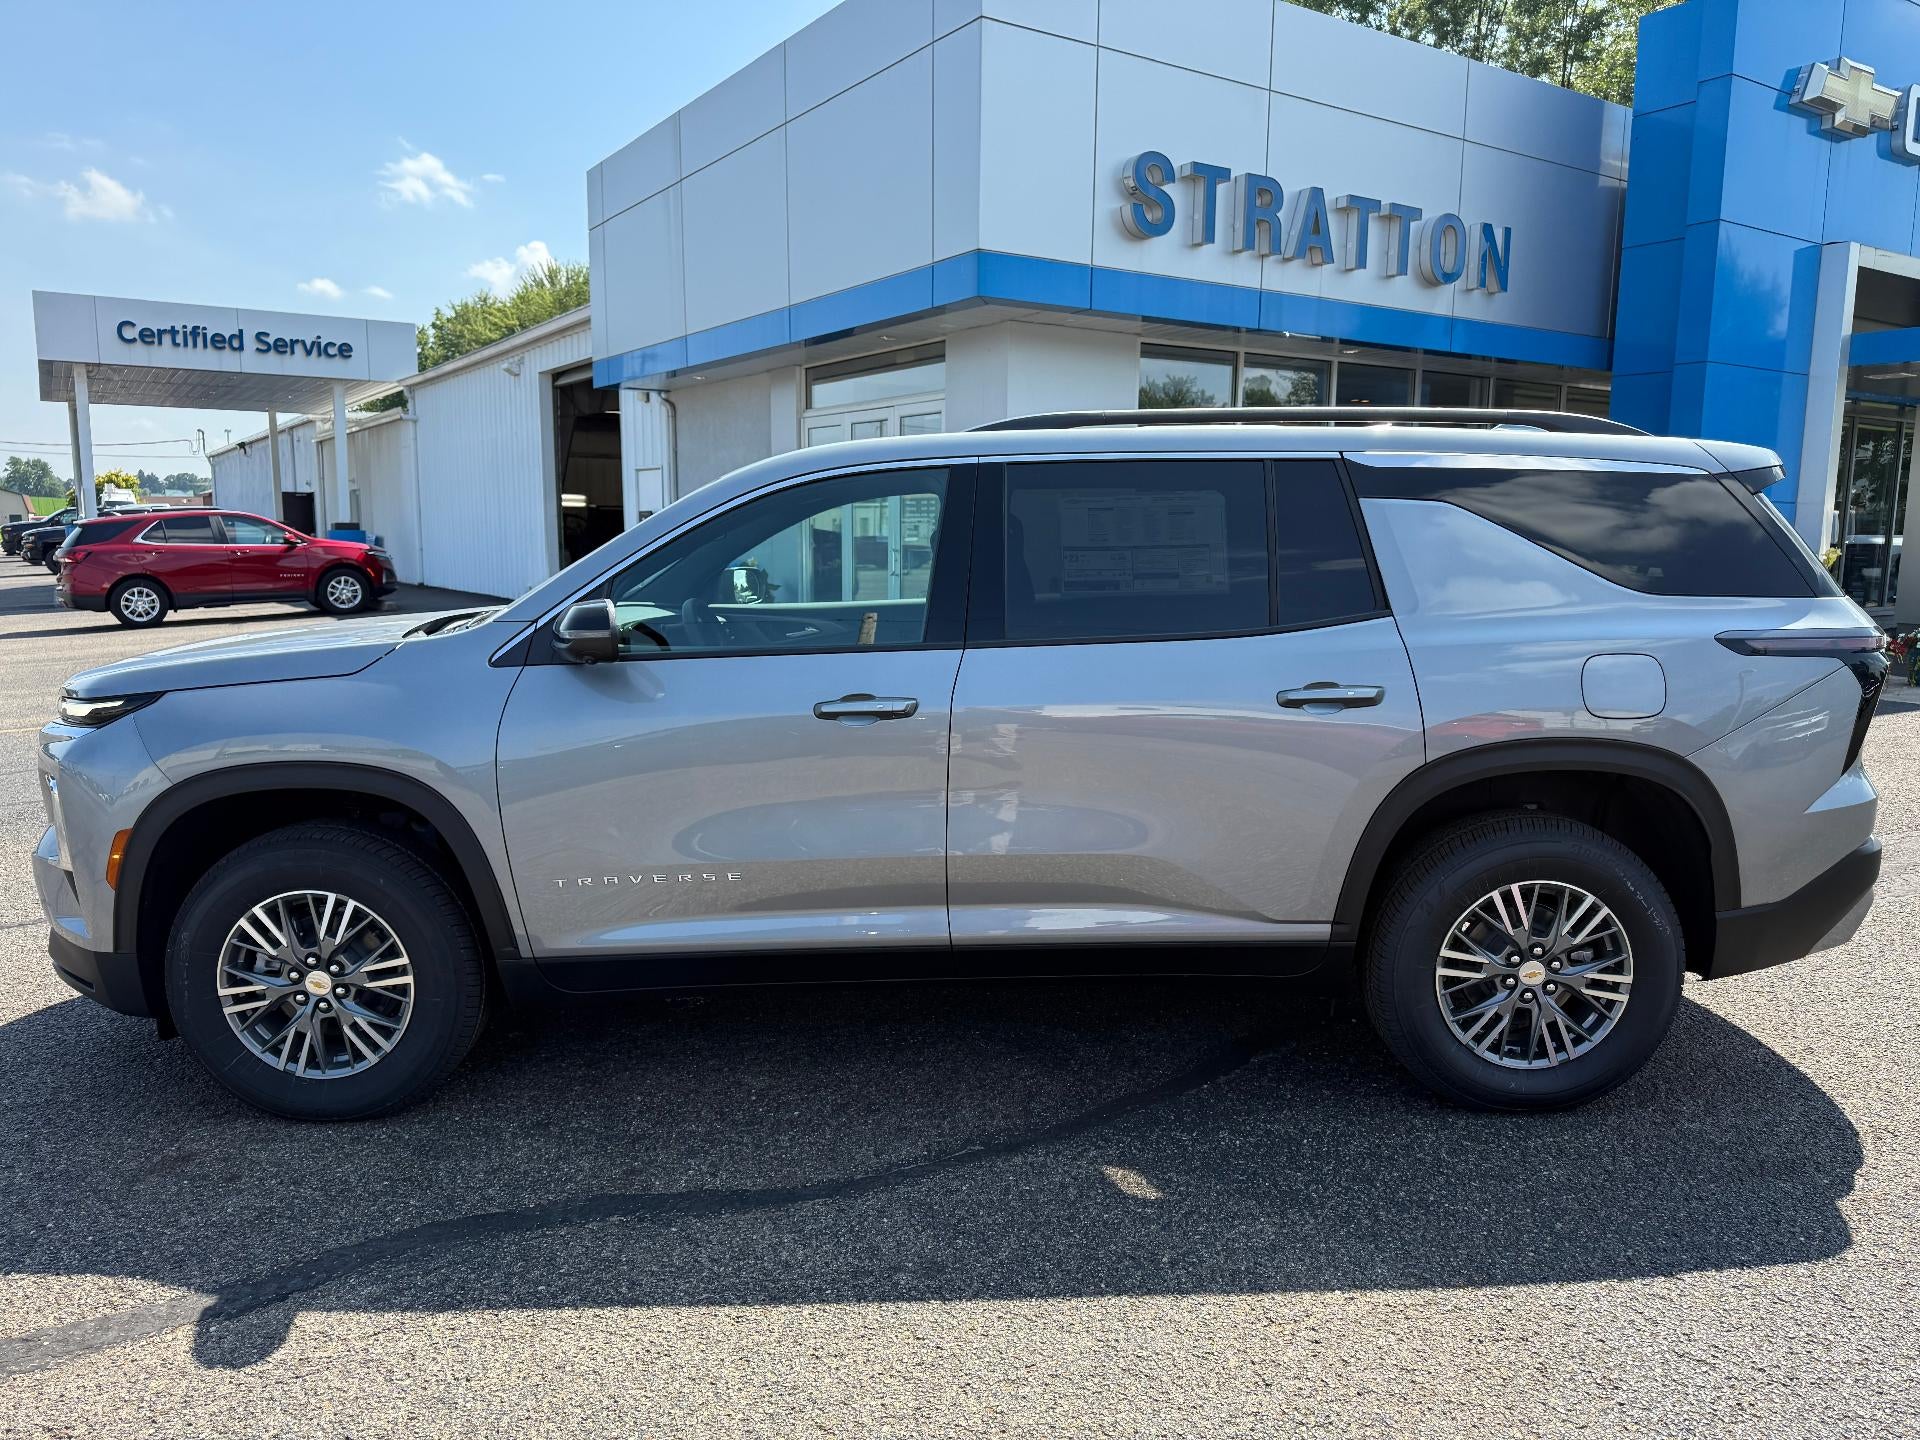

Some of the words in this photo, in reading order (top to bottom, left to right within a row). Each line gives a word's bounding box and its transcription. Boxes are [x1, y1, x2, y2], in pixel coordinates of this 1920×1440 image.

[1121, 151, 1511, 294] STRATTON
[117, 320, 244, 351] Certified
[255, 331, 353, 358] Service
[554, 872, 742, 888] TRAVERSE
